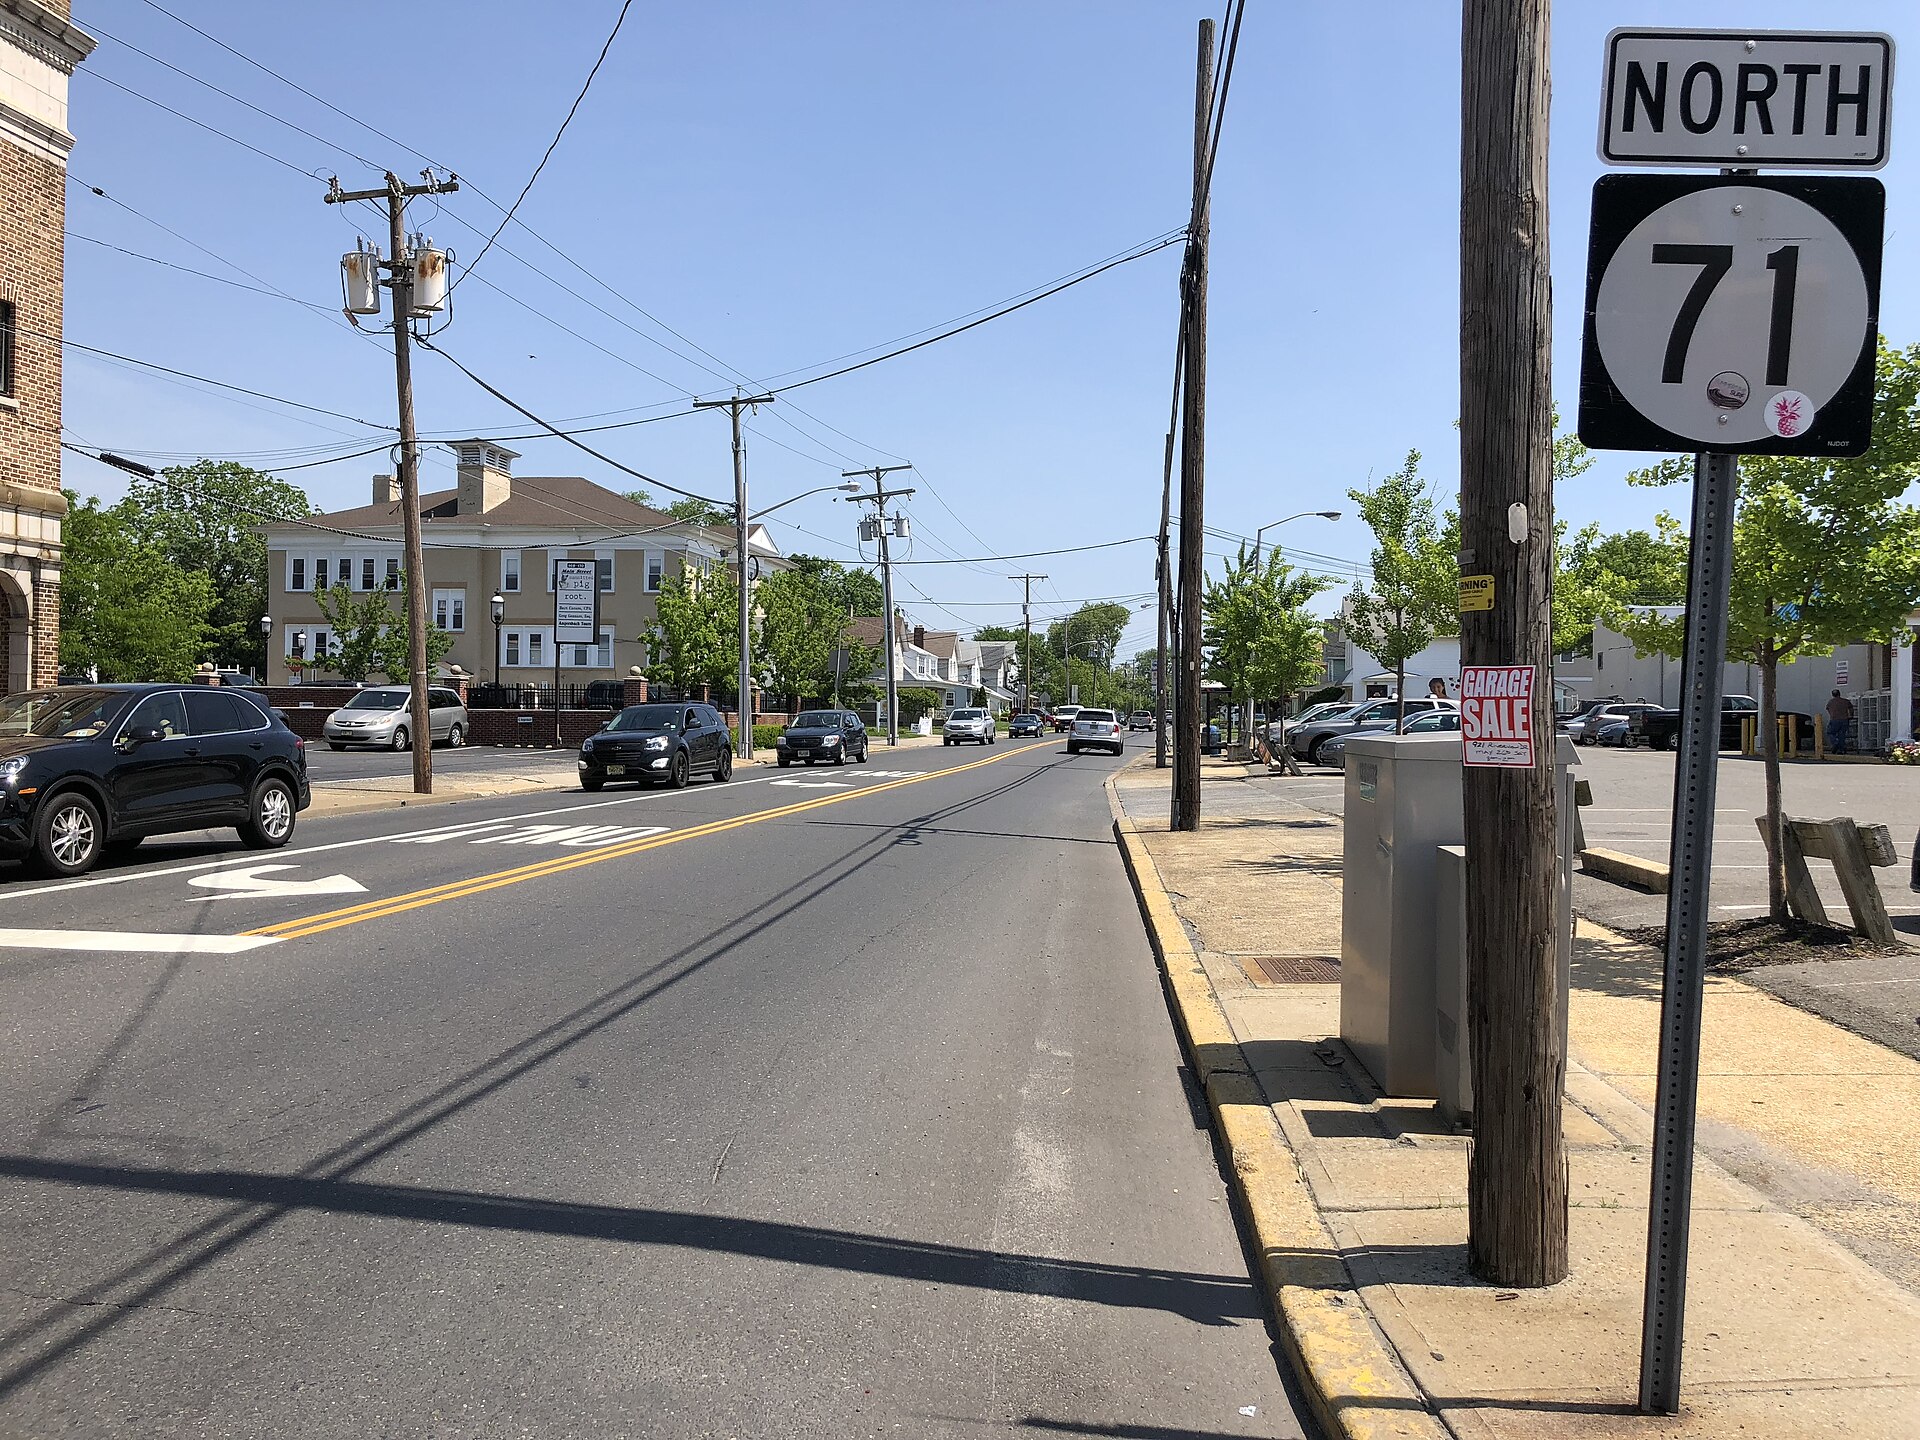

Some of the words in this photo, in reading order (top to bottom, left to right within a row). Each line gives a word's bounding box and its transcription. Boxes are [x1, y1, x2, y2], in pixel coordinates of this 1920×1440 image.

[1622, 61, 1871, 136] NORTH
[1652, 243, 1800, 386] 71
[573, 580, 590, 589] pig
[1459, 579, 1488, 590] RNING
[1463, 669, 1531, 698] GARAGE
[1462, 699, 1529, 740] SALE
[389, 824, 671, 847] ONLY
